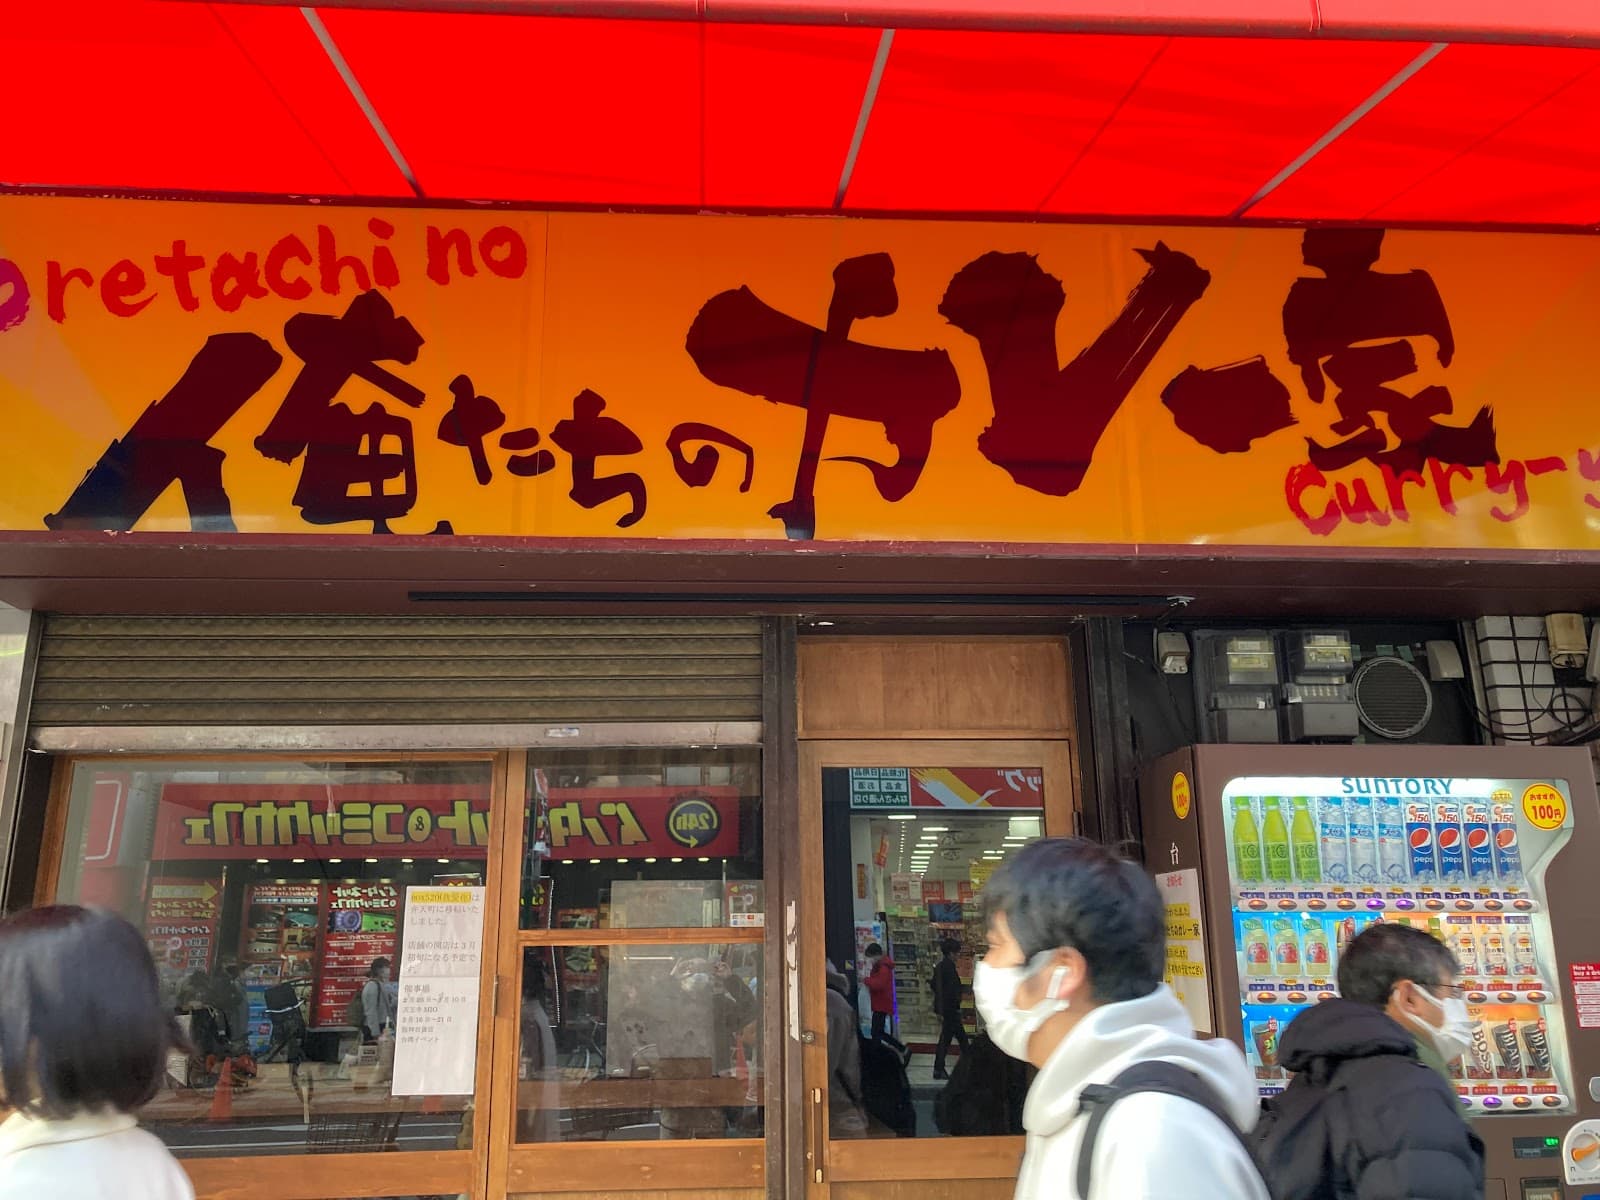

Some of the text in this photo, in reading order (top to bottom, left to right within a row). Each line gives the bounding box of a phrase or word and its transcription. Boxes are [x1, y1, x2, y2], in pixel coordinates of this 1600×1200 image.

[0, 218, 527, 331] oretachi no
[44, 228, 1499, 537] 俺たちのカレー家
[1532, 805, 1561, 820] 100円
